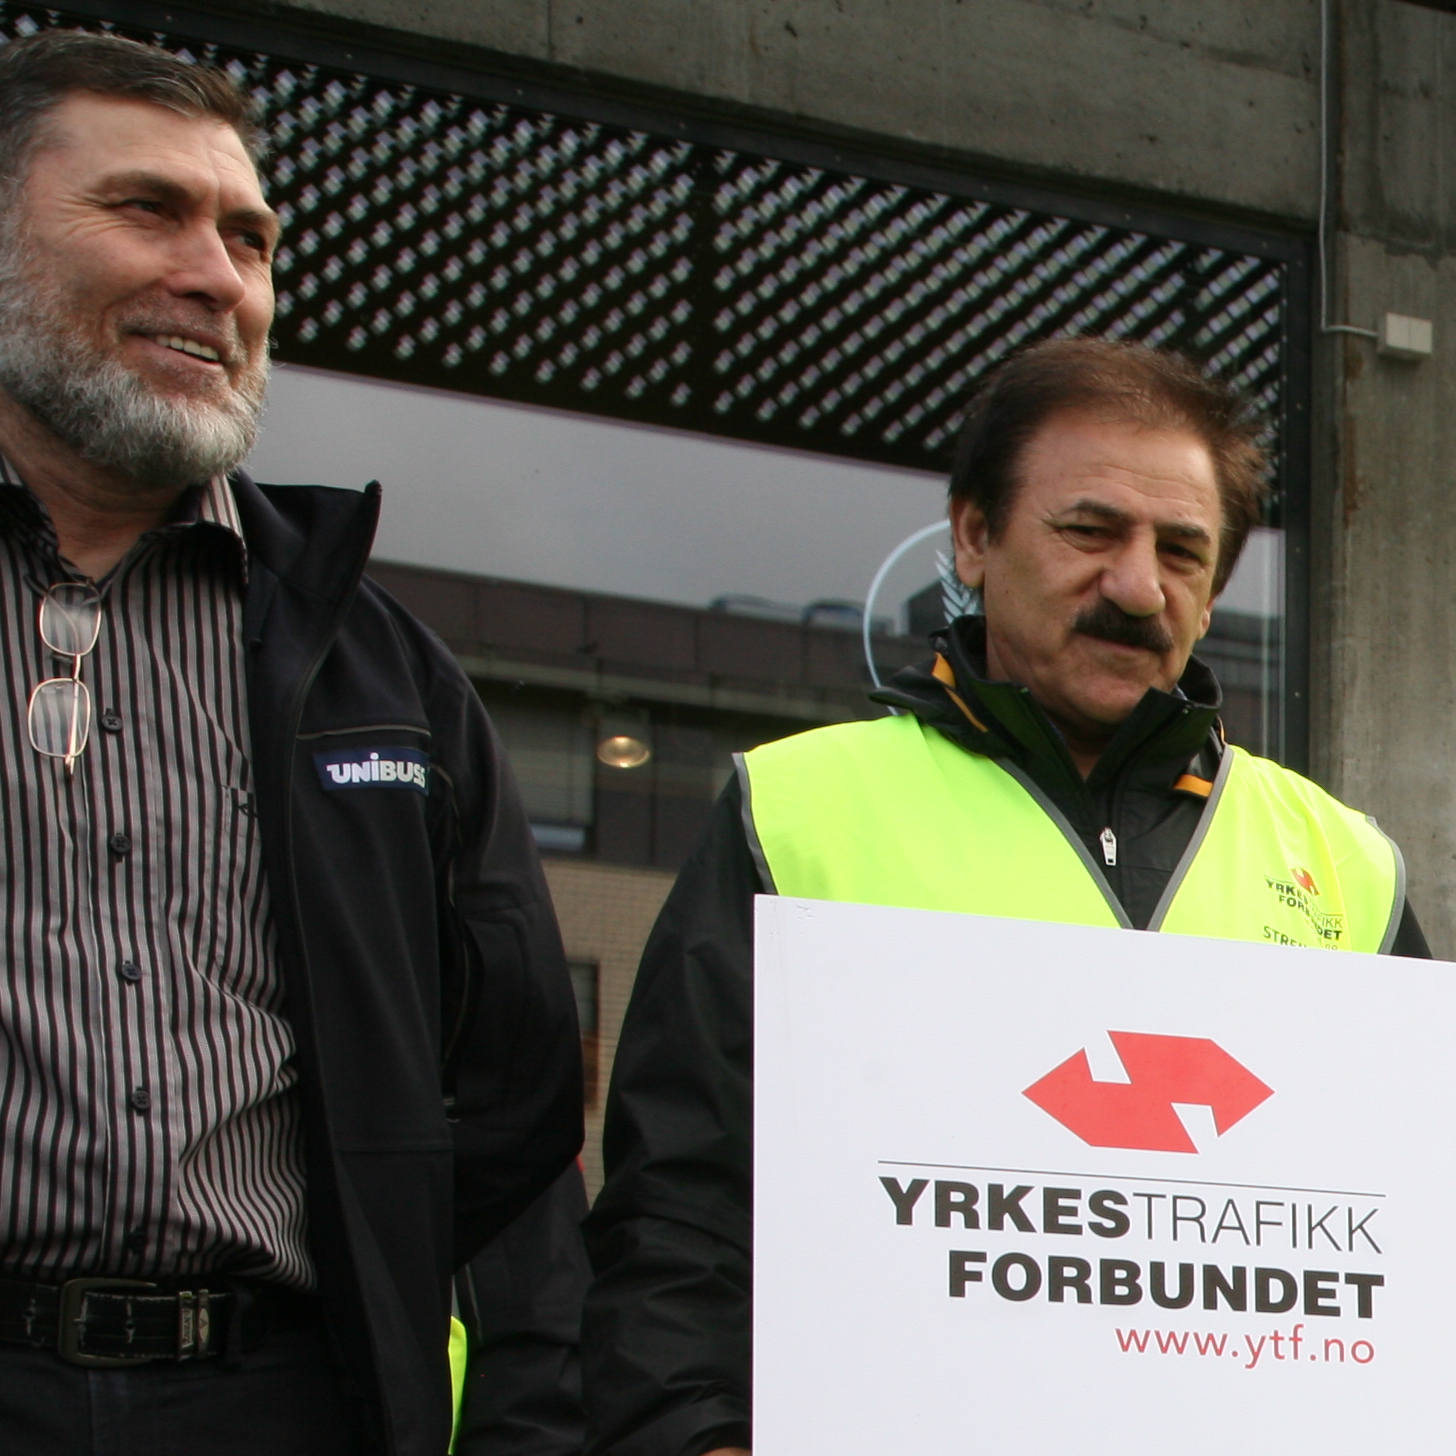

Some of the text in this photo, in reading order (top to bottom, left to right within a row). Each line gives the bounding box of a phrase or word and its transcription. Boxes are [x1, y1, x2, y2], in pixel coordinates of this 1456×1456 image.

[878, 1176, 1383, 1255] YRKESTRAFIKK
[949, 1250, 1385, 1319] FORBUNDET
[1115, 1324, 1375, 1370] www.ytf.no
